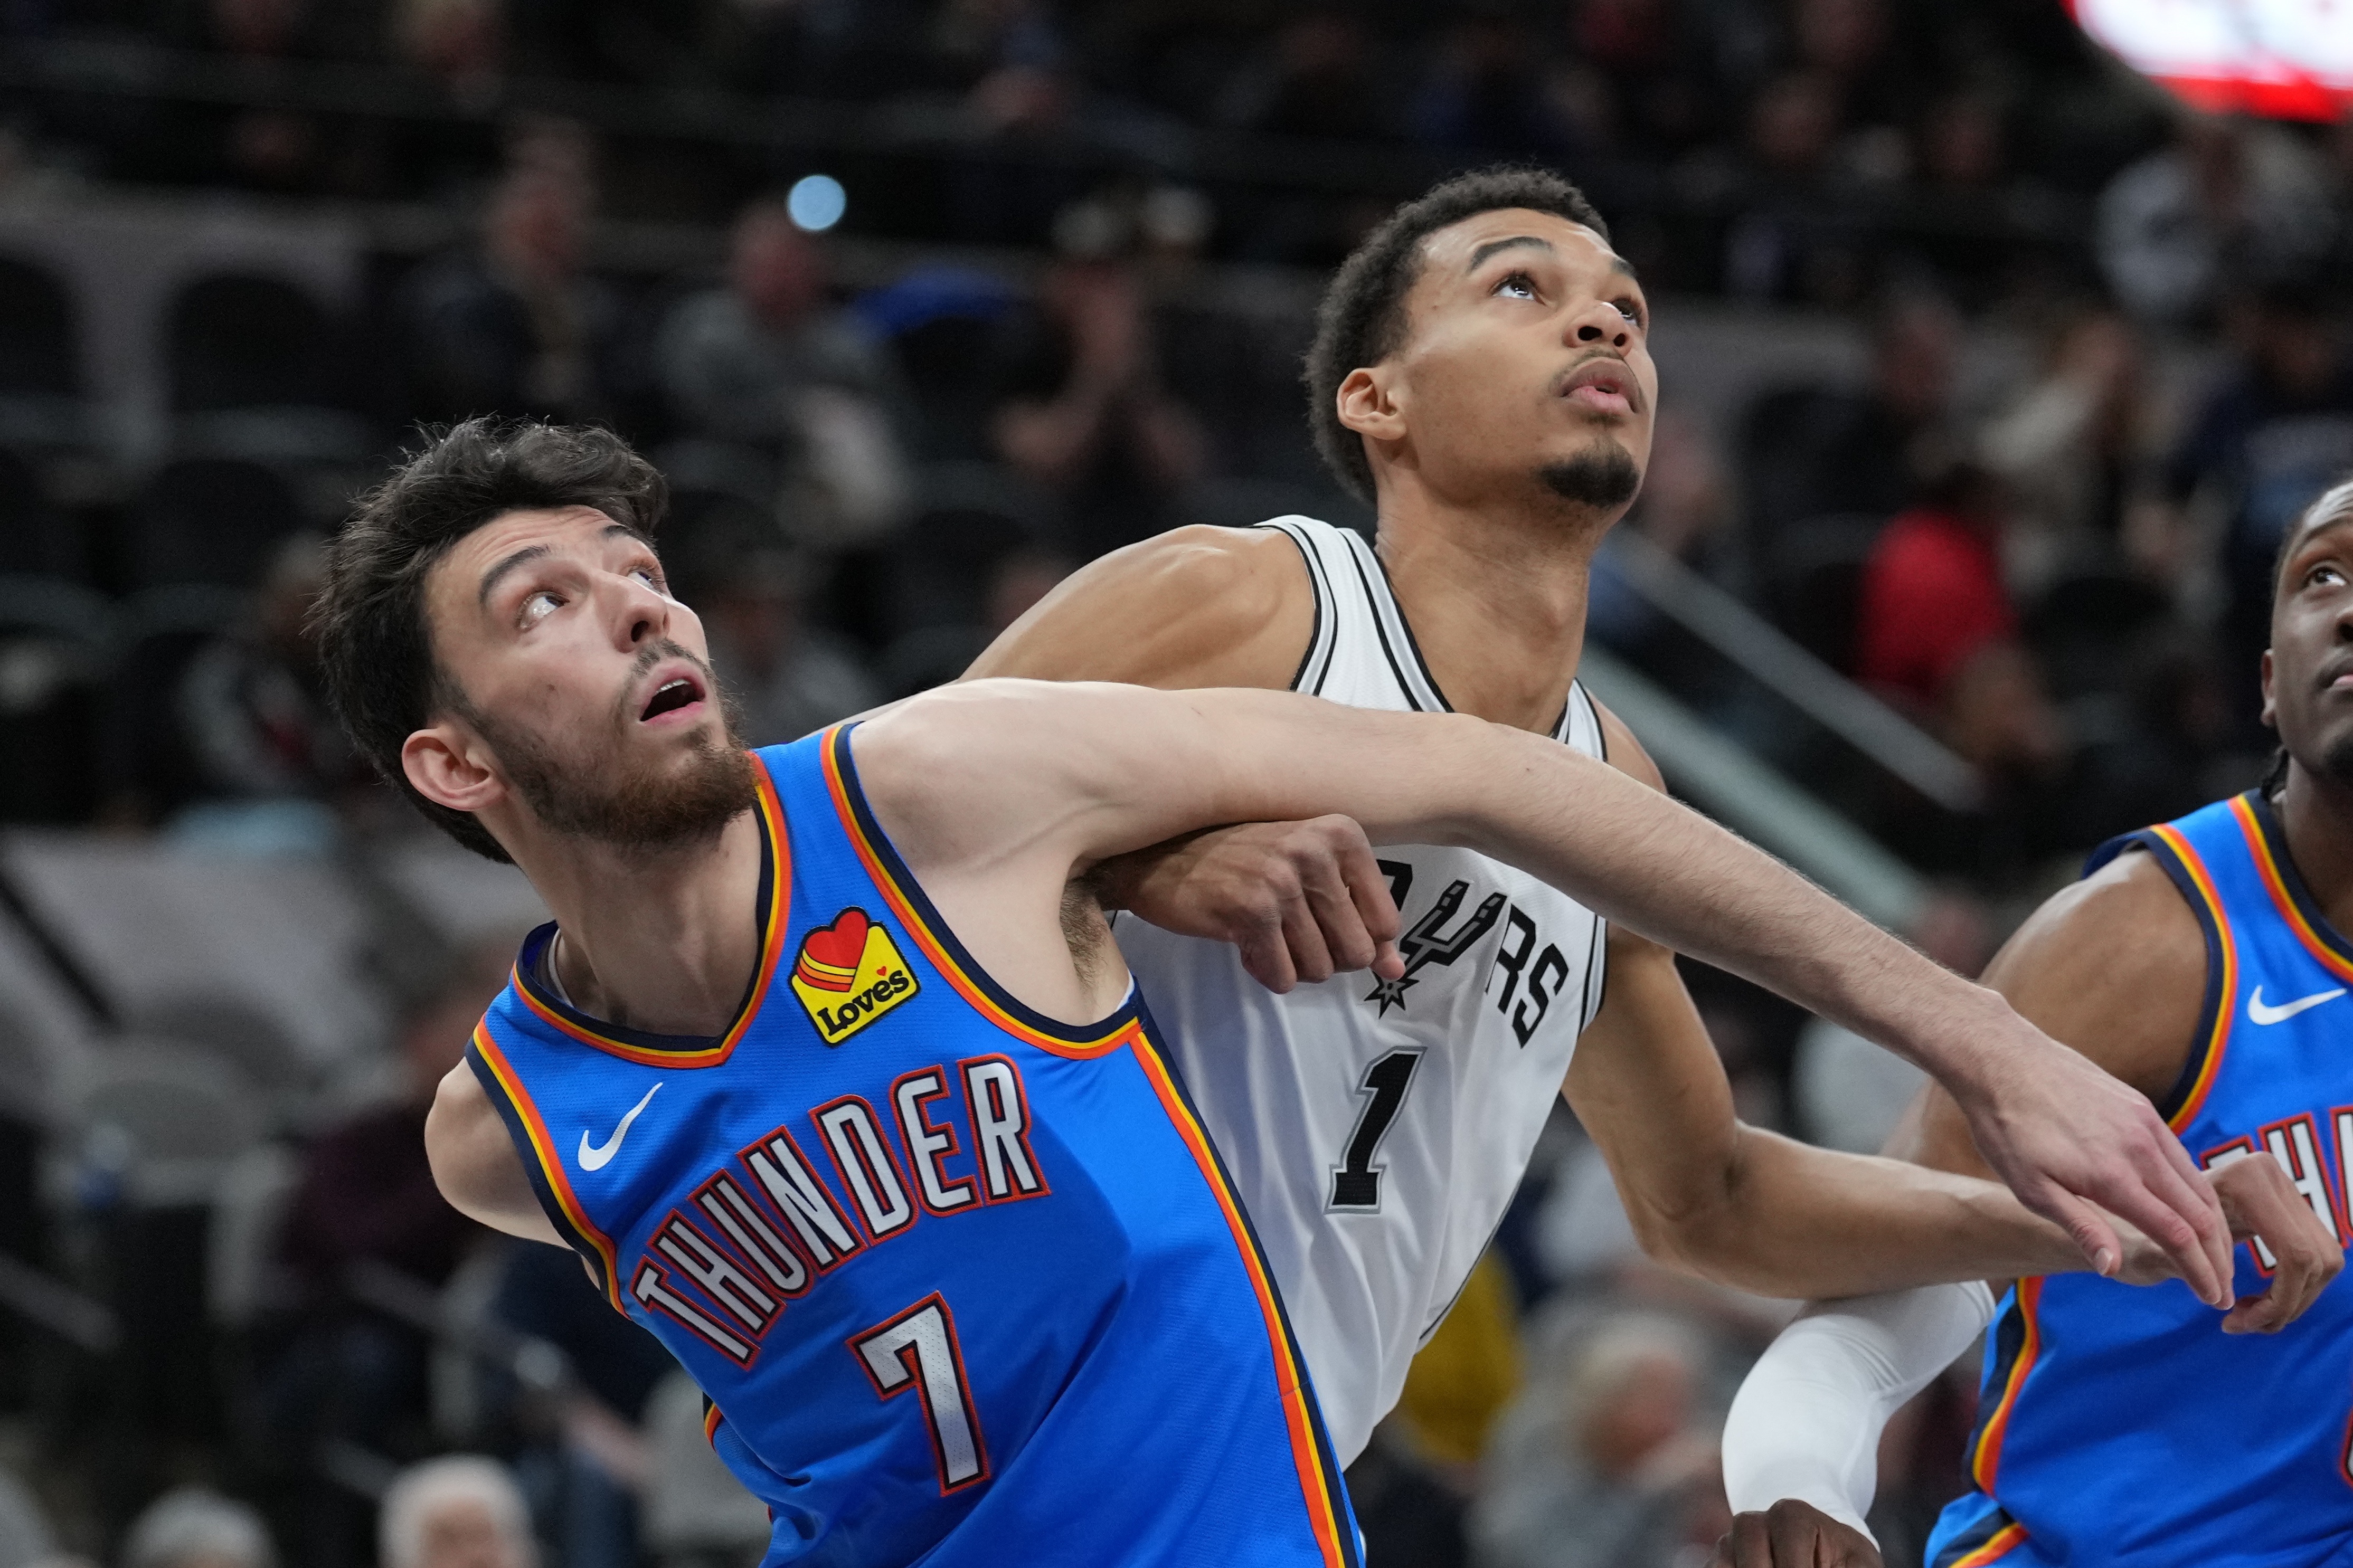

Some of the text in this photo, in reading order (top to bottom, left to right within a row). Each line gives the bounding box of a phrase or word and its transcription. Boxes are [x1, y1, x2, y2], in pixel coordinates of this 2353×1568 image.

[630, 1053, 1051, 1371] THUNDER
[1324, 1046, 1428, 1214] 1
[847, 1290, 991, 1497] 7
